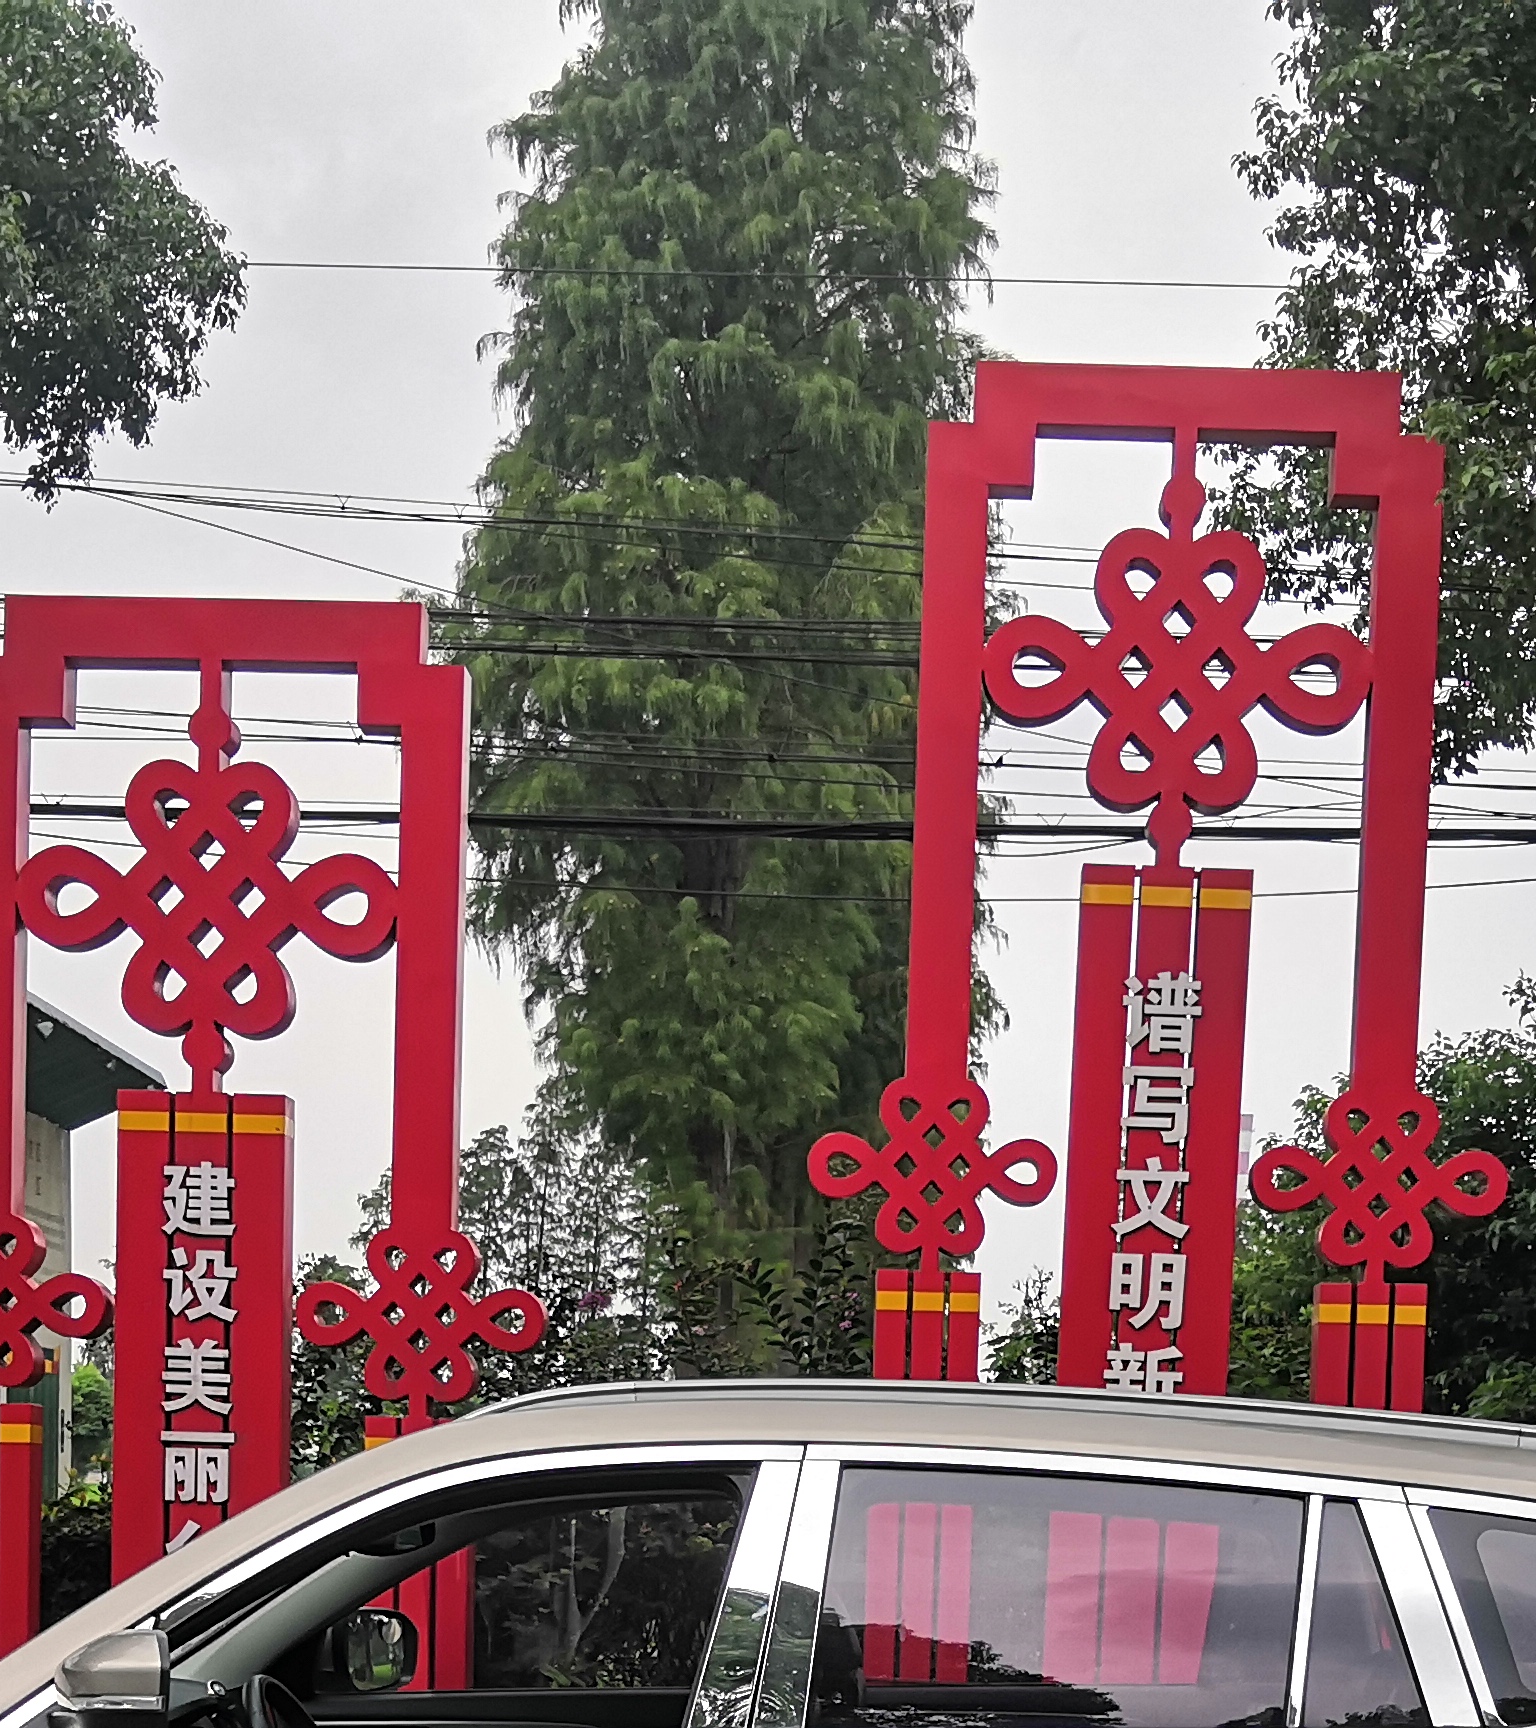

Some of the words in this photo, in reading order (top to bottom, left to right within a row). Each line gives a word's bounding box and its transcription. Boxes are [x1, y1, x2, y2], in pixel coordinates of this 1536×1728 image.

[161, 1161, 238, 1556] 建设美丽
[1103, 972, 1202, 1395] 谱写文明新
